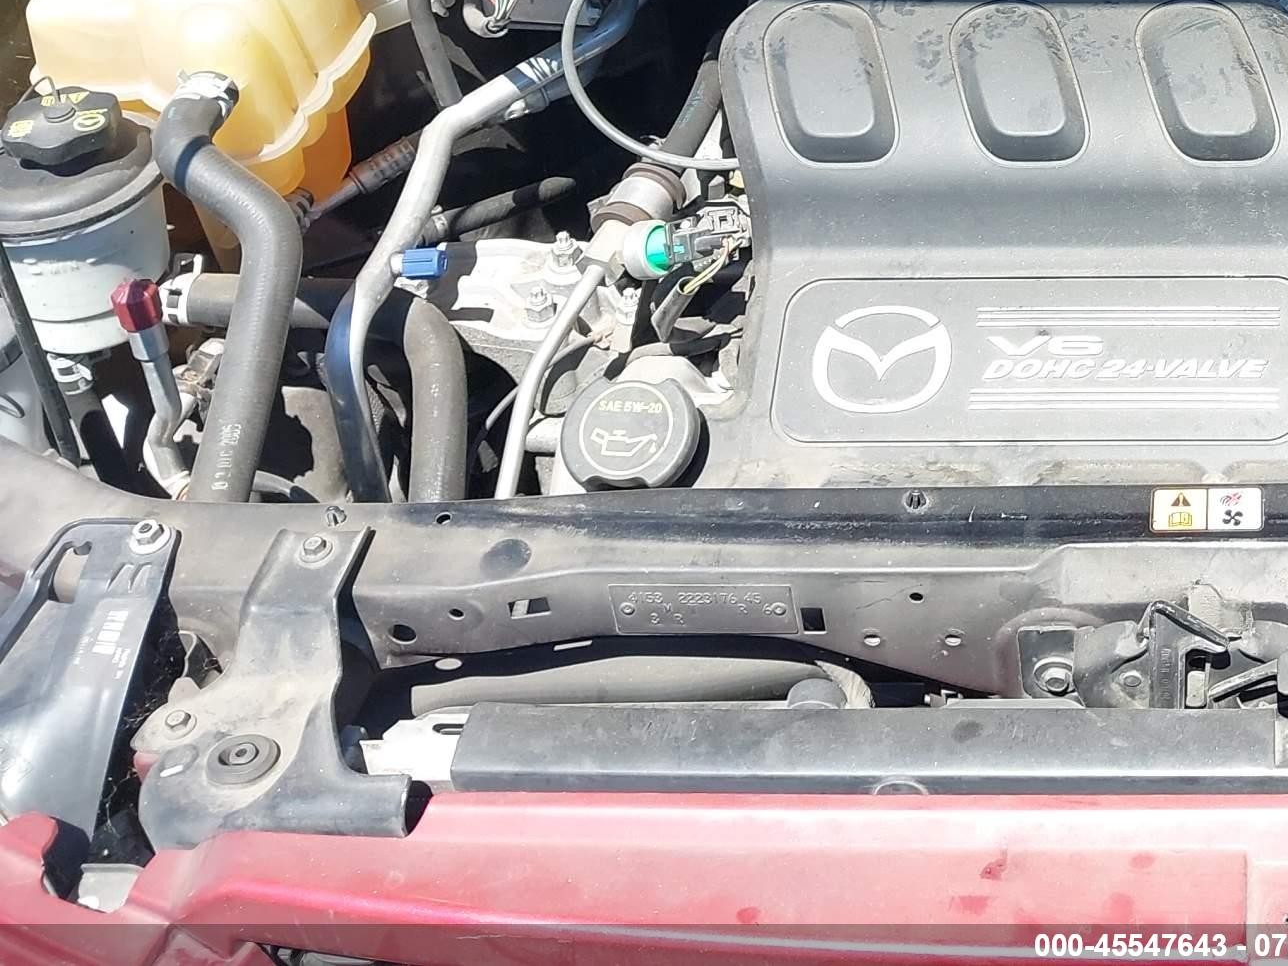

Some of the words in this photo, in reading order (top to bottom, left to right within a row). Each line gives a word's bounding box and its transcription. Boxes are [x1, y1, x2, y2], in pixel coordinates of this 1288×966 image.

[986, 334, 1104, 357] V6
[983, 359, 1097, 380] DOHC
[599, 400, 623, 412] SAE
[623, 401, 663, 414] 5W-20
